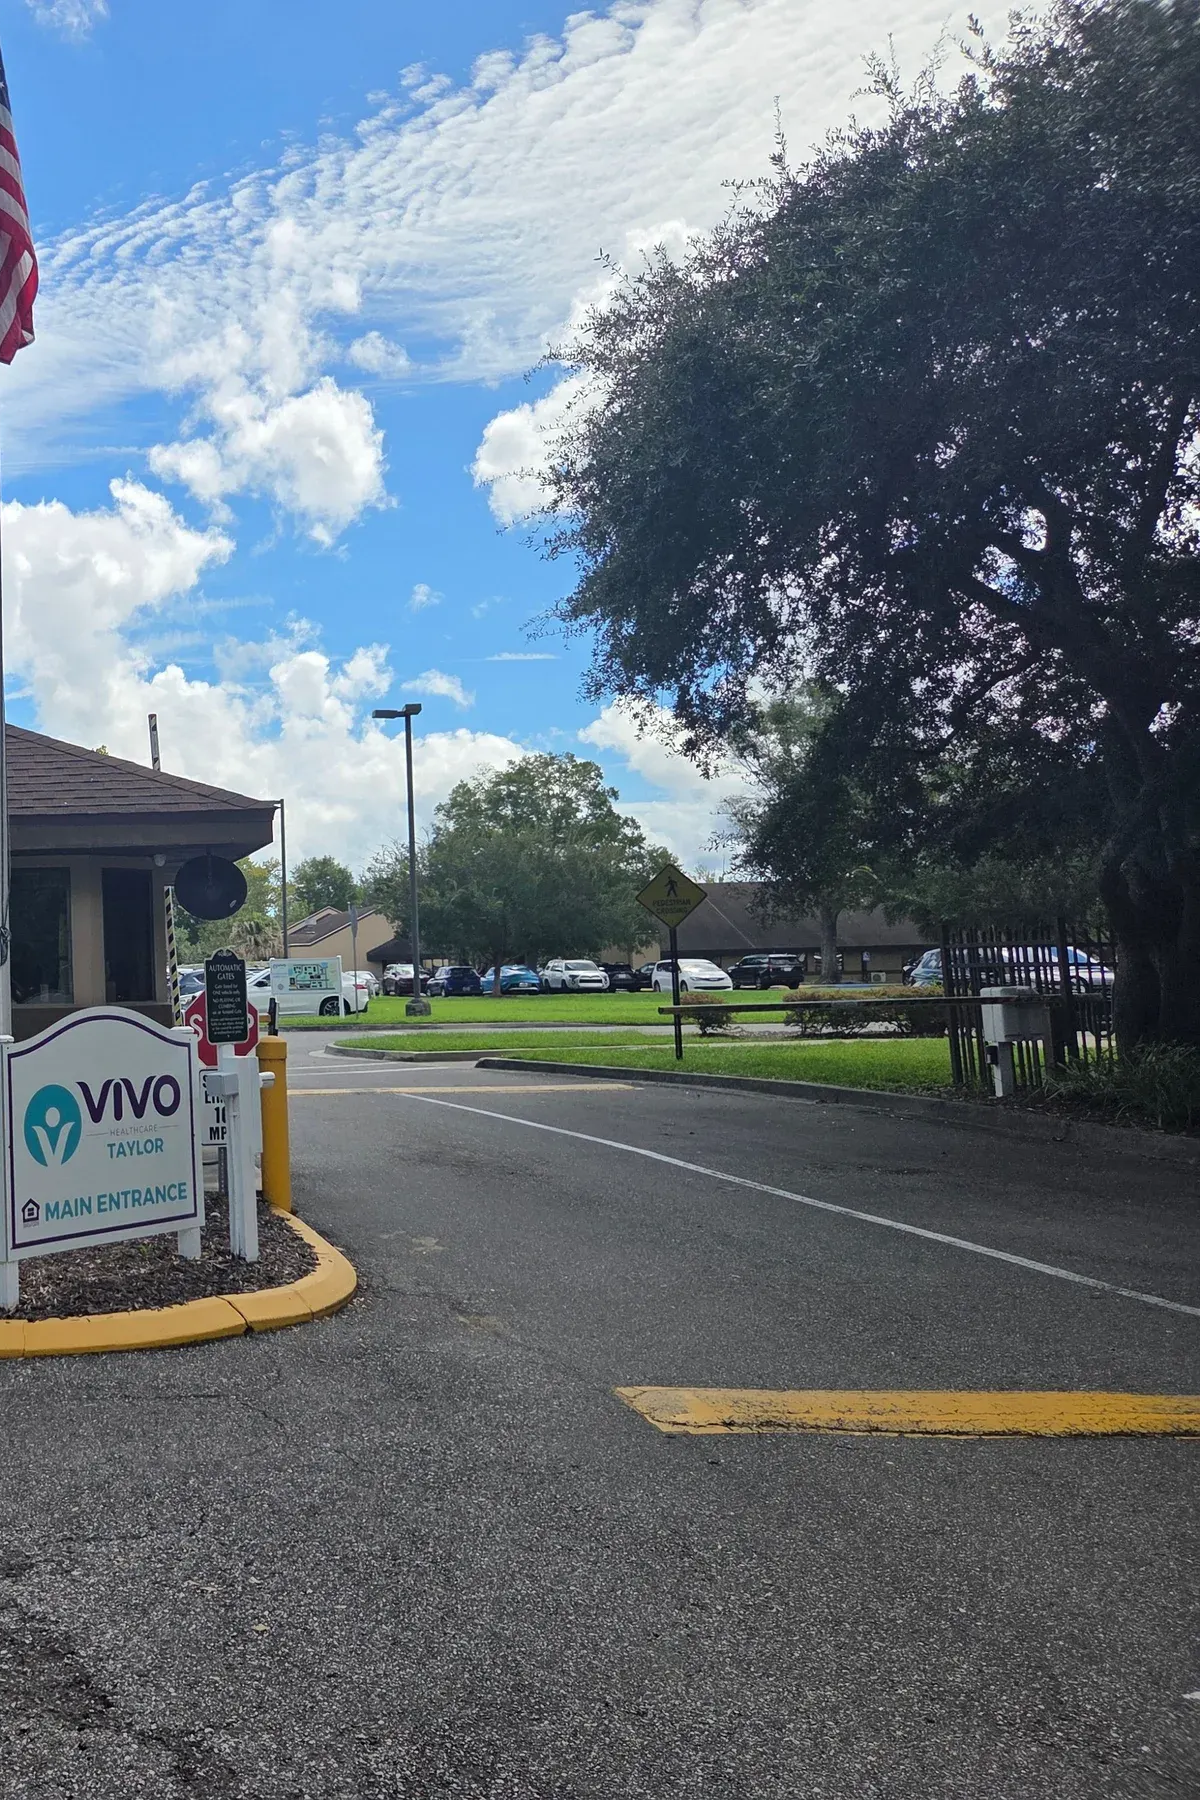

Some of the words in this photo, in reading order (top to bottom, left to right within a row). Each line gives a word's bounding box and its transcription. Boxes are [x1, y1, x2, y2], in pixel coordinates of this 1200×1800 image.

[652, 898, 691, 907] PEDESTRIAN
[208, 963, 242, 972] AUTOMATIC
[217, 972, 235, 980] GATES
[75, 1074, 181, 1123] VIVO
[110, 1124, 158, 1136] HEALTHCARE
[209, 1126, 227, 1140] MP
[107, 1137, 164, 1159] TAYLOR
[45, 1196, 92, 1221] MAIN
[97, 1182, 187, 1214] ENTRANCE
